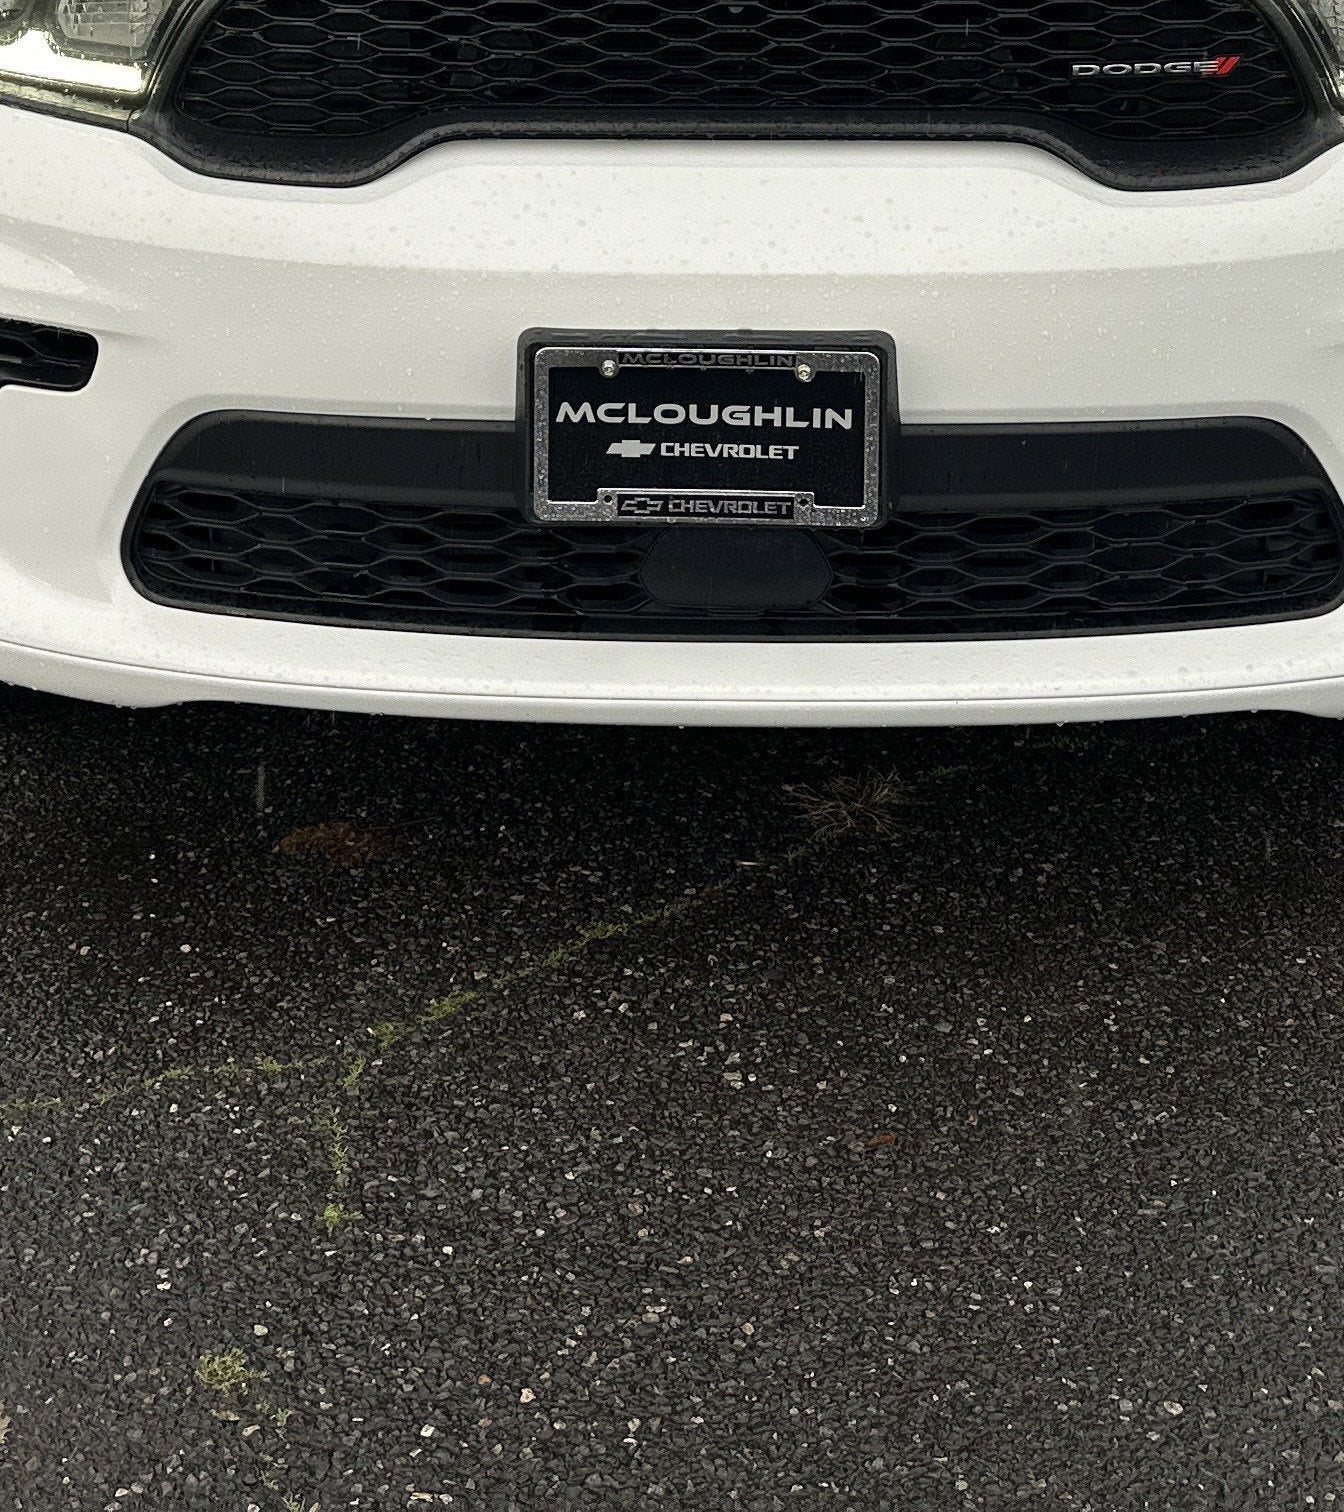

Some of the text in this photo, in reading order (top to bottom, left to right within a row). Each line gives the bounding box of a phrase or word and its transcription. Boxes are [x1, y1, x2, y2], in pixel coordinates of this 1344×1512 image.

[1072, 61, 1219, 77] DODGE
[621, 352, 793, 367] MCLOUGHLIN
[556, 401, 853, 430] MCLOUGHLIN
[660, 442, 800, 460] CHEVROLET
[667, 498, 792, 516] CHEVROLET
